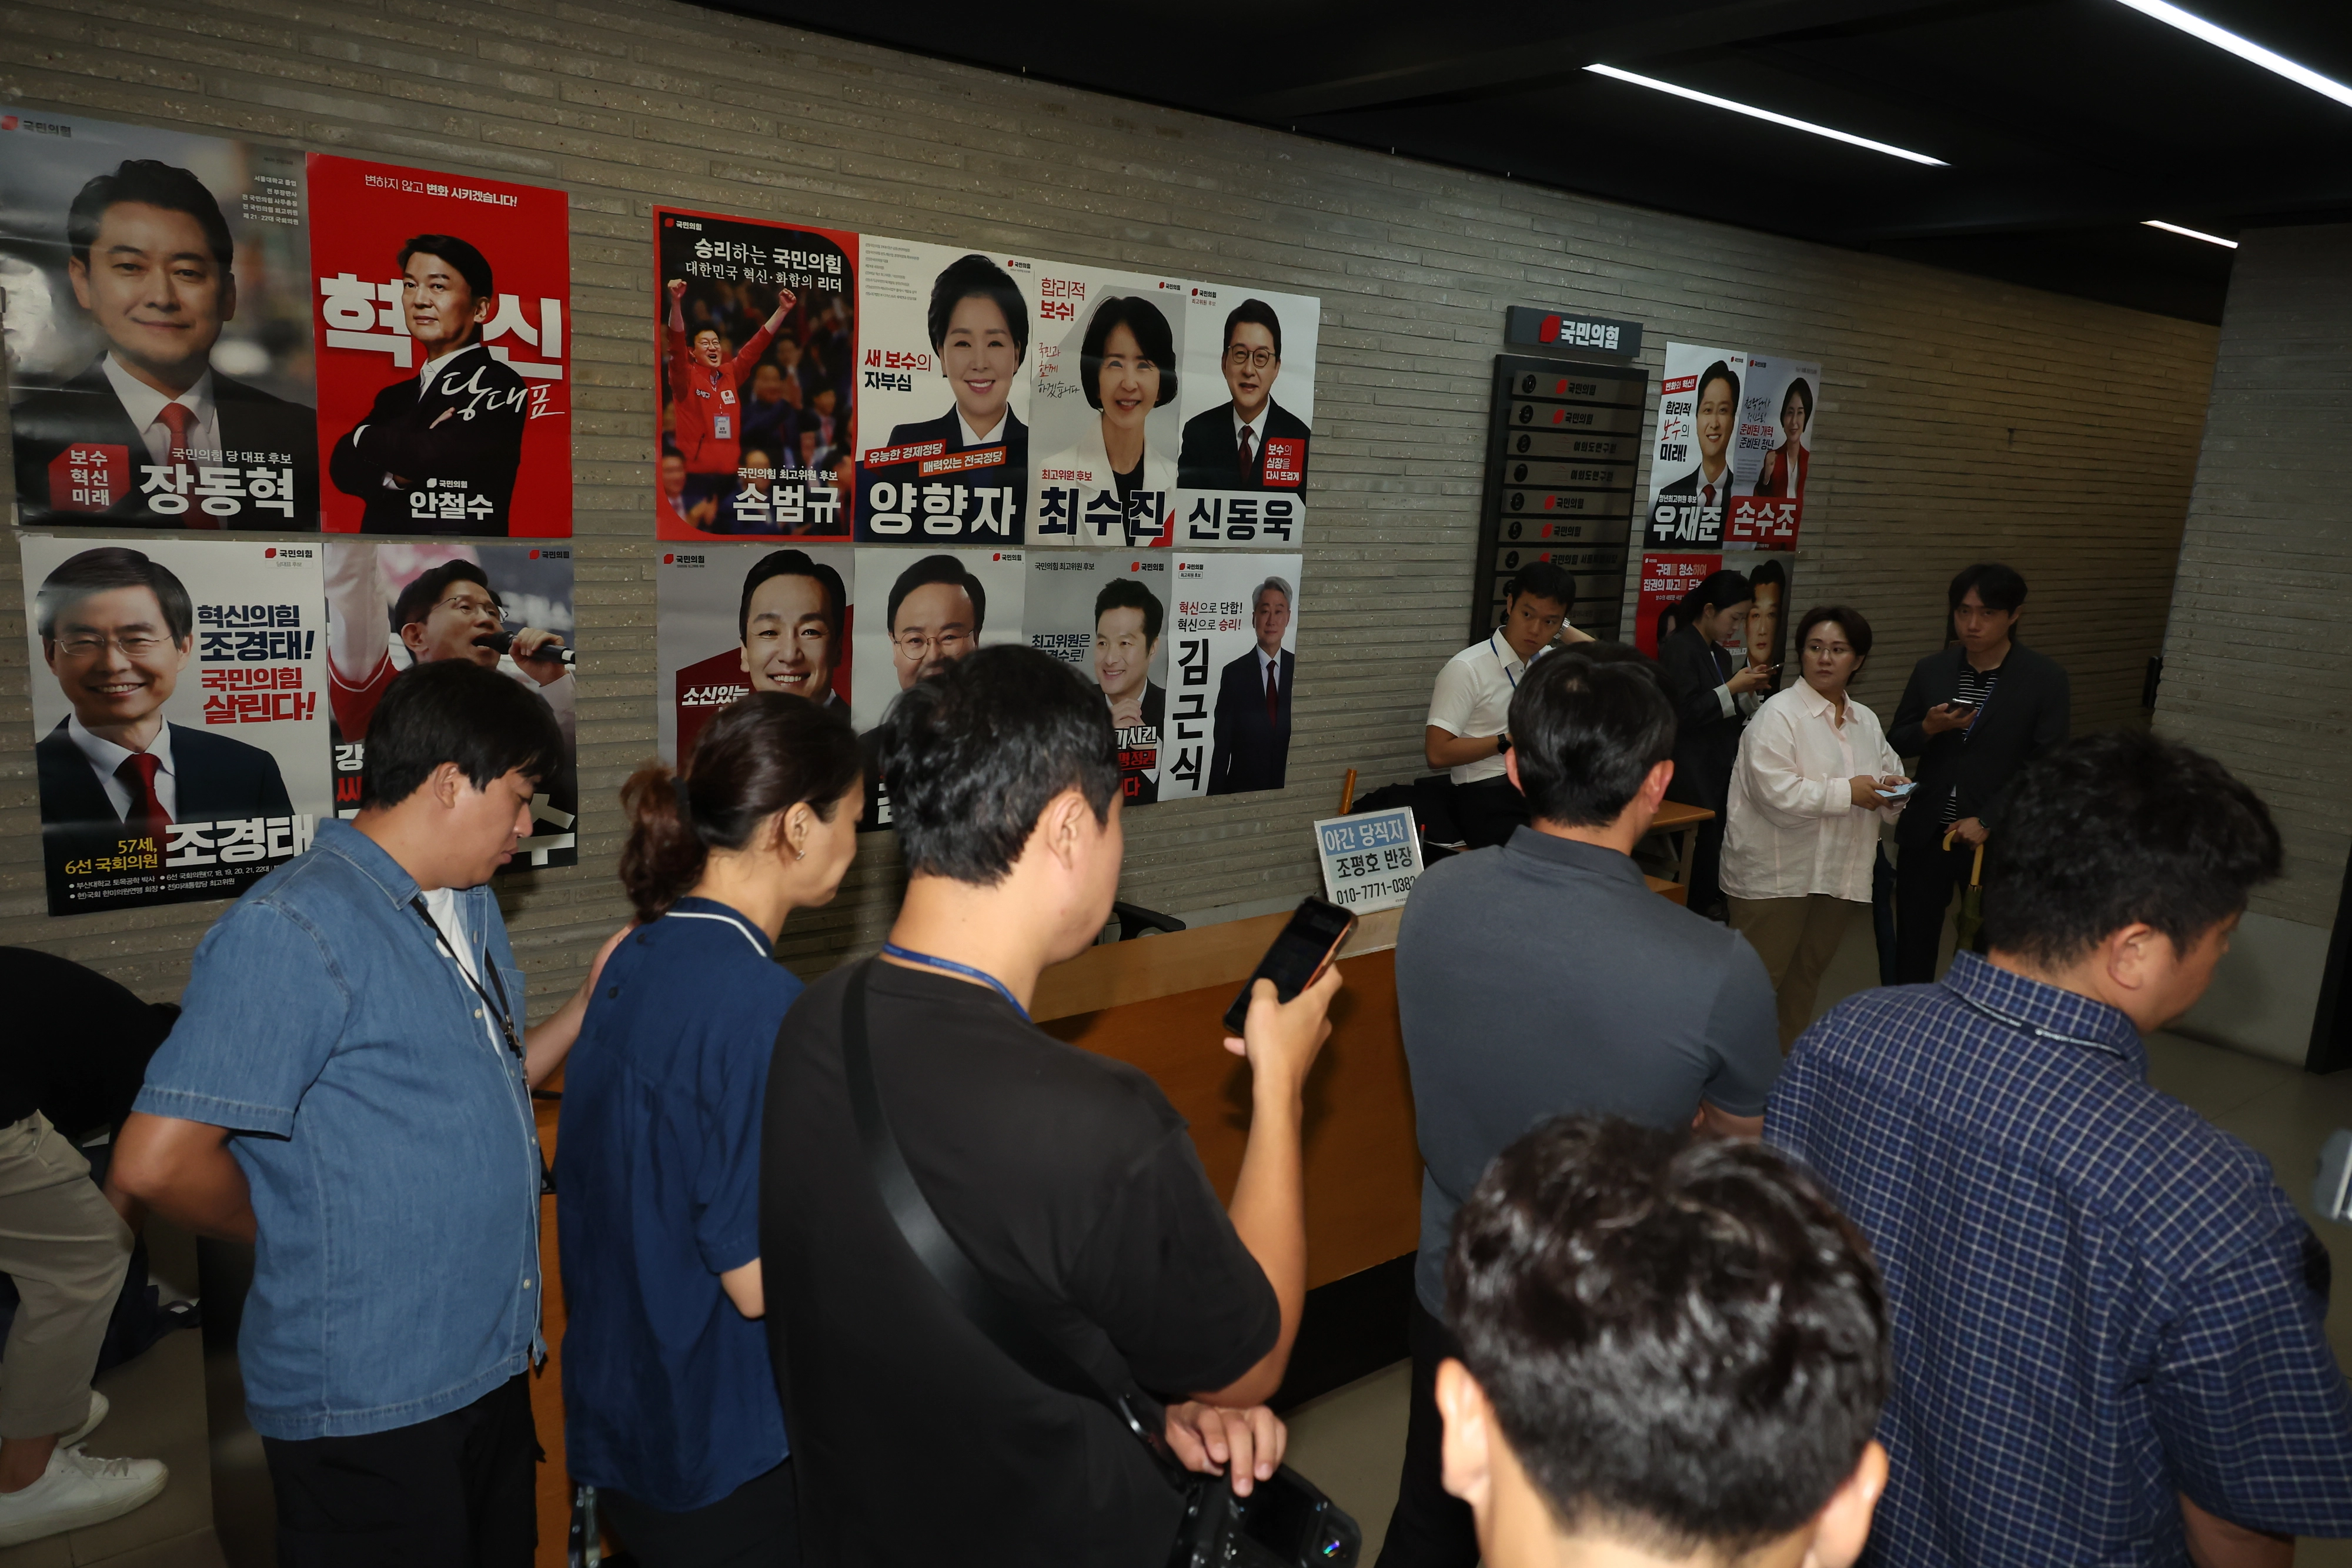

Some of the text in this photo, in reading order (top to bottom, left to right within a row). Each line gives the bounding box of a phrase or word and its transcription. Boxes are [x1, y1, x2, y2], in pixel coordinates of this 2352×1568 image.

[23, 119, 72, 138] 국민의힘
[365, 174, 518, 207] 변하지 않고 변화 시키겠습니다!
[676, 220, 702, 231] 국민의힘
[694, 238, 841, 275] 승리하는 국민의힘
[685, 260, 739, 281] 대한민국
[817, 276, 842, 293] 리더
[1041, 277, 1085, 301] 합리적
[1165, 283, 1181, 291] 국민의힘
[1199, 290, 1217, 298] 국민의힘
[1040, 300, 1074, 321] 보수!
[1561, 320, 1620, 350] 국민의힘
[1038, 342, 1061, 359] 국민과
[864, 349, 931, 372] 새 보수의
[1038, 360, 1058, 377] 함께
[864, 371, 912, 392] 자부심
[1038, 379, 1081, 398] 하겠습니다
[1568, 382, 1596, 396] 국민의힘
[1665, 378, 1695, 392] 변화와 혁신!
[1665, 401, 1692, 416] 합리적
[1565, 412, 1593, 424] 국민의힘
[1661, 409, 1690, 441] 보수의
[1739, 424, 1774, 437] 준비된 개혁
[1268, 443, 1292, 456] 보수의
[1660, 443, 1688, 462] 미래!
[1739, 437, 1775, 450] 준비된 청년
[69, 449, 108, 467] 보수
[172, 447, 293, 465] 국민의힘 당 대표 후보
[868, 443, 943, 464] 유능한 경제정당
[923, 450, 1003, 473] 매력있는 전국정당
[1267, 457, 1290, 469] 심장을
[70, 469, 109, 487] 혁신
[737, 467, 838, 482] 국민의힘 최고위원 후보
[1041, 469, 1092, 482] 최고위원 후보
[1266, 470, 1299, 482] 다시 뜨겁게
[139, 463, 295, 518] 장동혁
[439, 480, 468, 489] 국민의힘
[72, 488, 111, 506] 미래
[409, 492, 494, 520] 안철수
[733, 483, 841, 523] 손범규
[1556, 497, 1584, 509] 국민의힘
[1658, 494, 1698, 504] 청년최고위원 후보
[869, 482, 1016, 536] 양향자
[1038, 486, 1166, 537] 최수진
[1188, 497, 1293, 541] 신동욱
[1653, 506, 1722, 541] 우재준
[1733, 502, 1797, 536] 손수조
[1553, 526, 1581, 537] 국민의힘
[279, 550, 313, 558] 국민의힘
[542, 550, 570, 559] 국민의힘
[676, 555, 705, 564] 국민의힘
[1551, 554, 1578, 565] 국민의힘
[1034, 562, 1058, 571] 국민의힘
[1060, 561, 1083, 571] 최고위원
[1141, 563, 1164, 571] 국민의힘
[1679, 563, 1707, 576] 청소하여
[1643, 579, 1665, 591] 집권의
[197, 604, 300, 628] 혁신의힘
[1179, 601, 1243, 616] 혁신으로 단합!
[1178, 618, 1241, 633] 혁신으로 승리!
[200, 630, 315, 662] 조경태!
[1031, 634, 1091, 648] 최고위원은
[201, 667, 302, 692] 국민의힘
[681, 685, 750, 706] 소신있는
[203, 691, 316, 725] 살린다!
[1170, 638, 1210, 791] 김근식
[165, 814, 315, 868] 조경태
[1325, 818, 1404, 851] 야간 당직자
[118, 837, 158, 855] 57세,
[65, 853, 159, 875] 6선 국회의원
[1336, 846, 1413, 879] 조평호 반장
[76, 880, 112, 890] 부산대학교
[112, 877, 141, 886] 토목공학
[102, 887, 143, 898] 한미의원연맹
[144, 885, 159, 893] 회장
[209, 878, 235, 887] 최고위원
